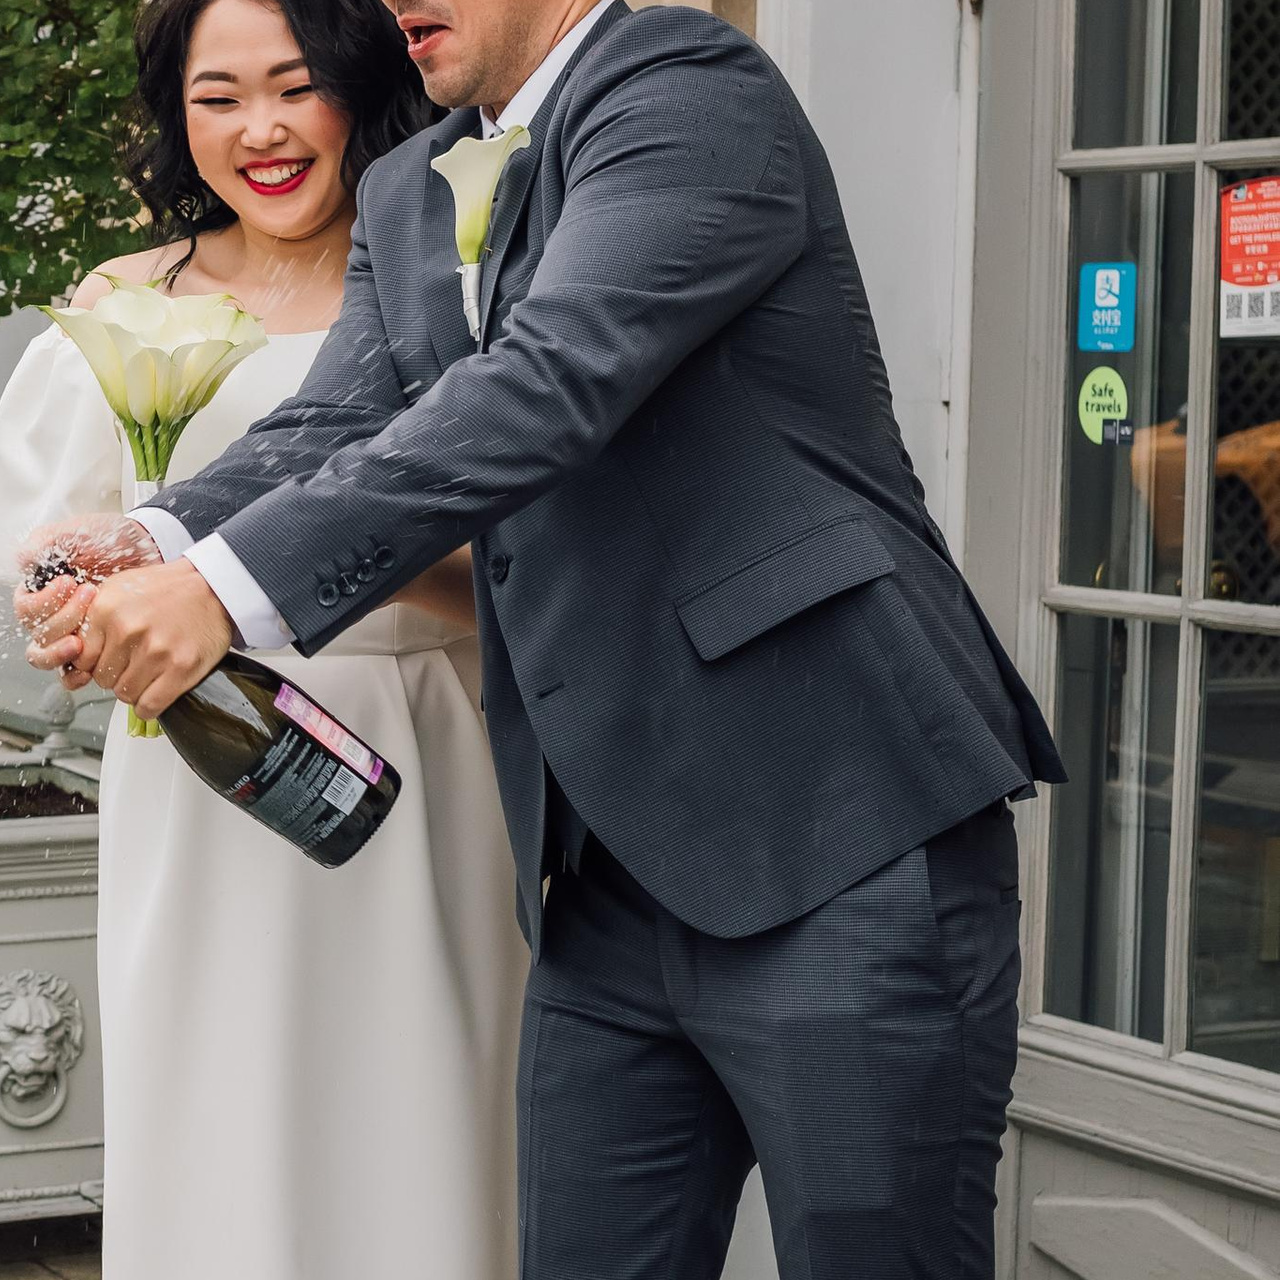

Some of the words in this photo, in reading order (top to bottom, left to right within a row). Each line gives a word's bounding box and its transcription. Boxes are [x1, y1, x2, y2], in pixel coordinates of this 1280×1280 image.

[1092, 309, 1121, 326] 支付宝
[1091, 382, 1114, 397] Safe
[1085, 399, 1121, 413] travels
